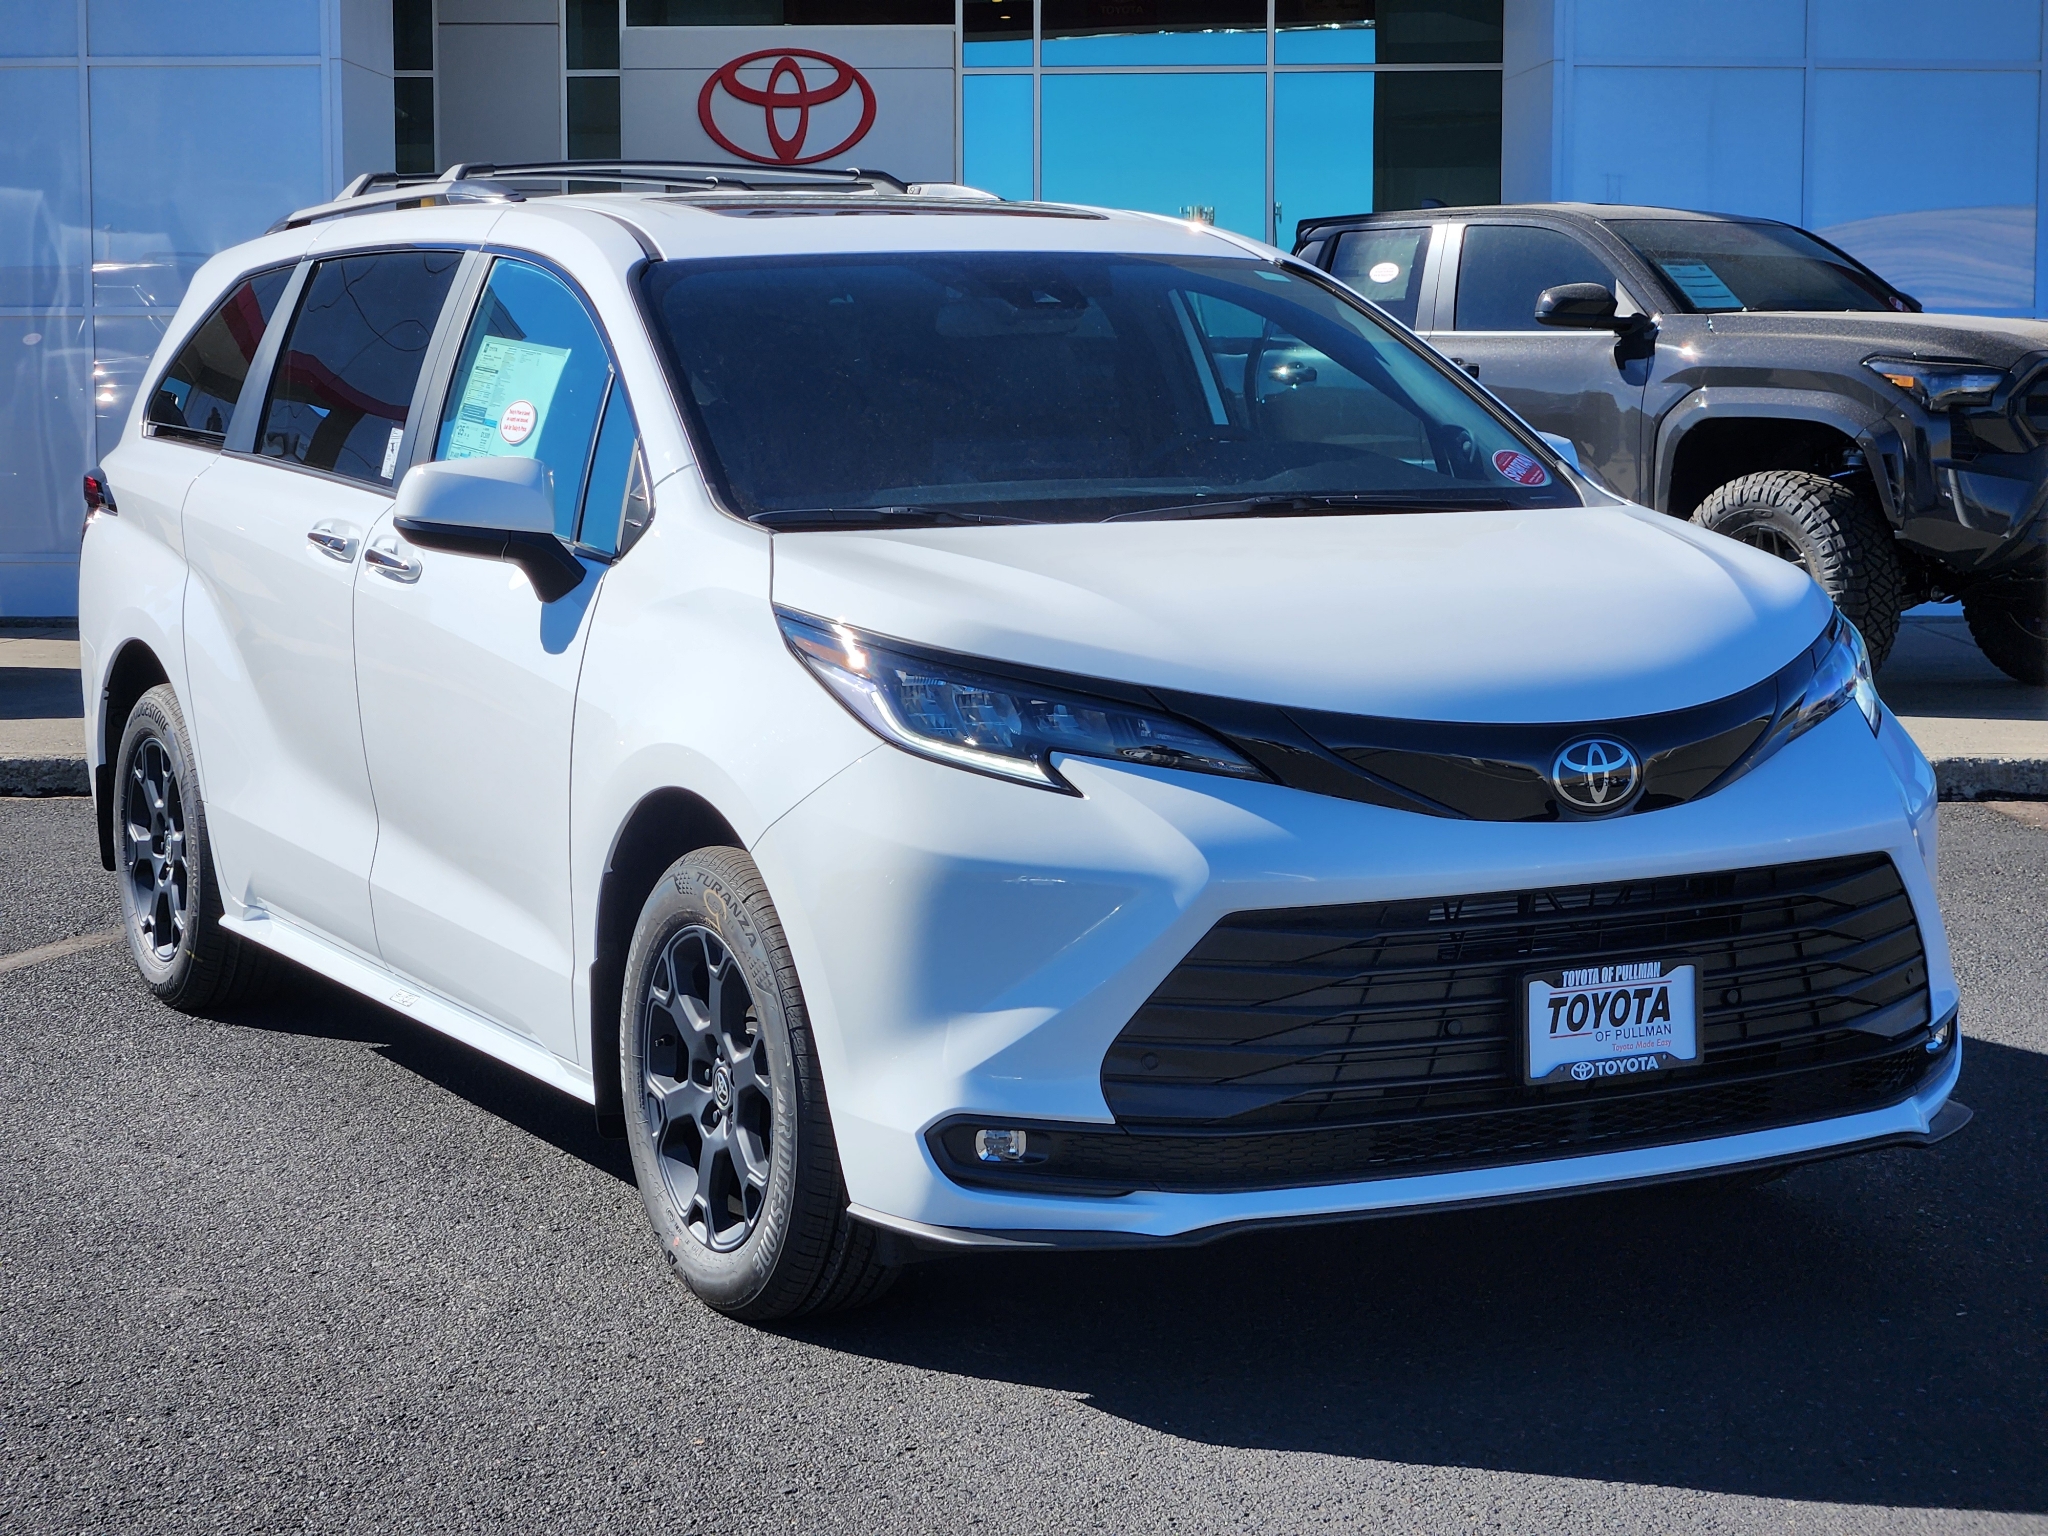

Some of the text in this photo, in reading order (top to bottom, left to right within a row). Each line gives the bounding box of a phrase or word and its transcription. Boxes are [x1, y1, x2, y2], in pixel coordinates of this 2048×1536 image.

[1098, 5, 1145, 14] TOYOTA
[696, 872, 757, 948] TURANZA
[1562, 961, 1661, 988] TOYOTA OF PULLMAN
[1547, 986, 1671, 1034] TOYOTA
[1595, 1024, 1672, 1042] OF PULLMAN
[1612, 1038, 1672, 1052] Toyota Made Easy
[1596, 1055, 1659, 1076] TOYOTA
[753, 1086, 794, 1278] BRIDGESTONE
